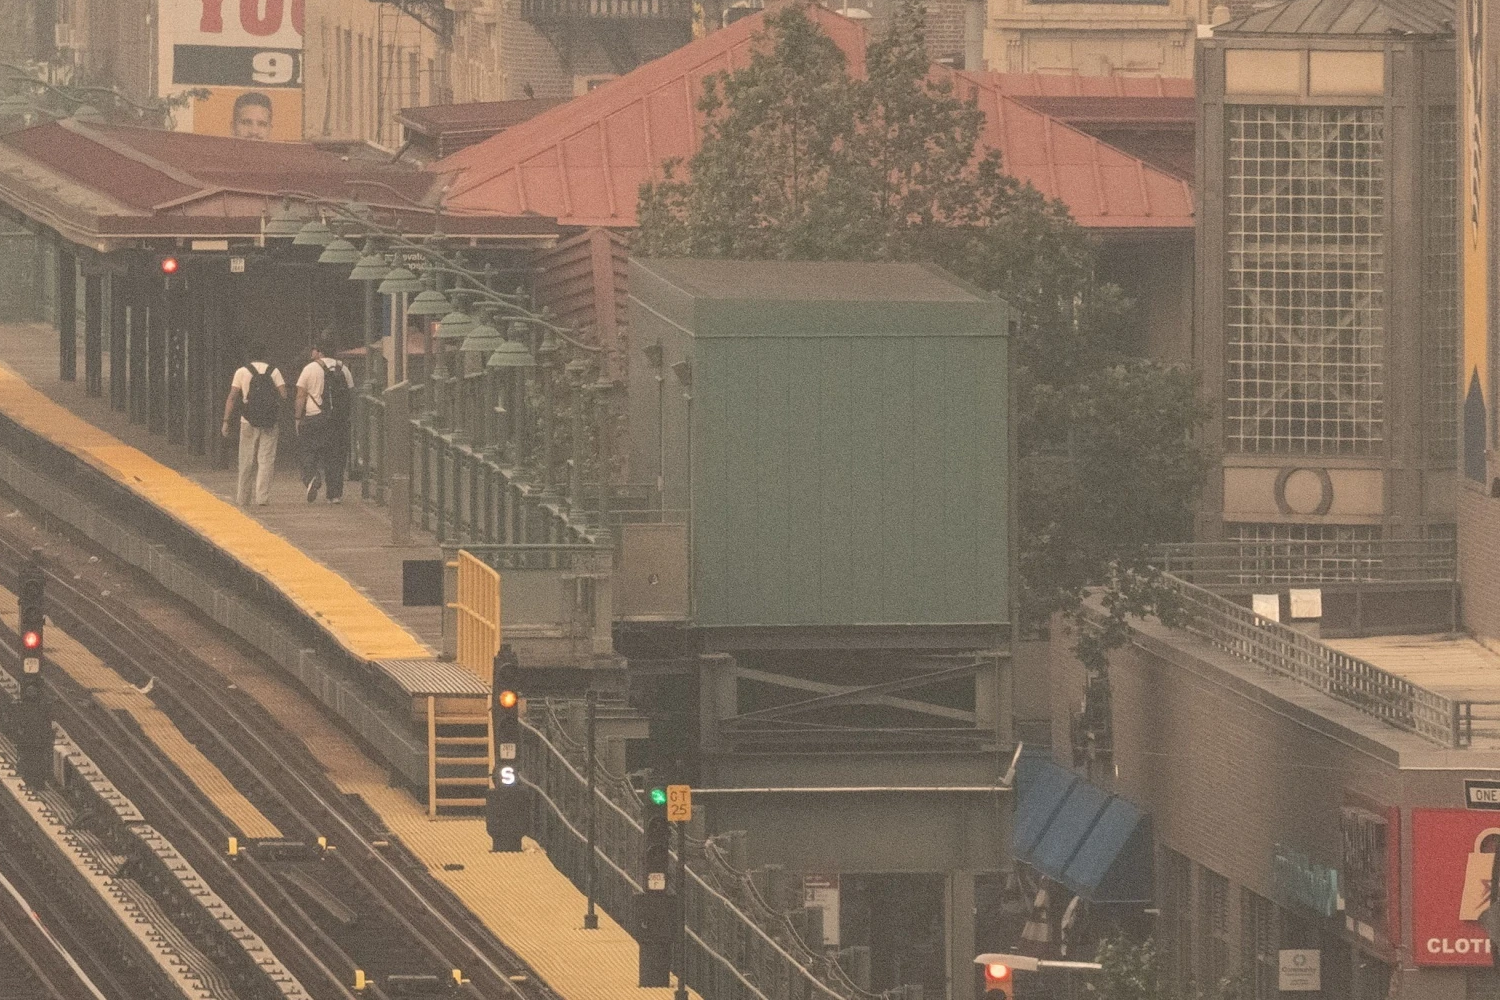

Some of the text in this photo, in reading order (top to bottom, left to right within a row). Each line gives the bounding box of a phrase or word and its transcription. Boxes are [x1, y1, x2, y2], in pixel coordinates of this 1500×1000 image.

[251, 51, 302, 84] 9
[501, 766, 515, 785] S
[1476, 789, 1498, 801] ONE
[671, 803, 688, 816] 25
